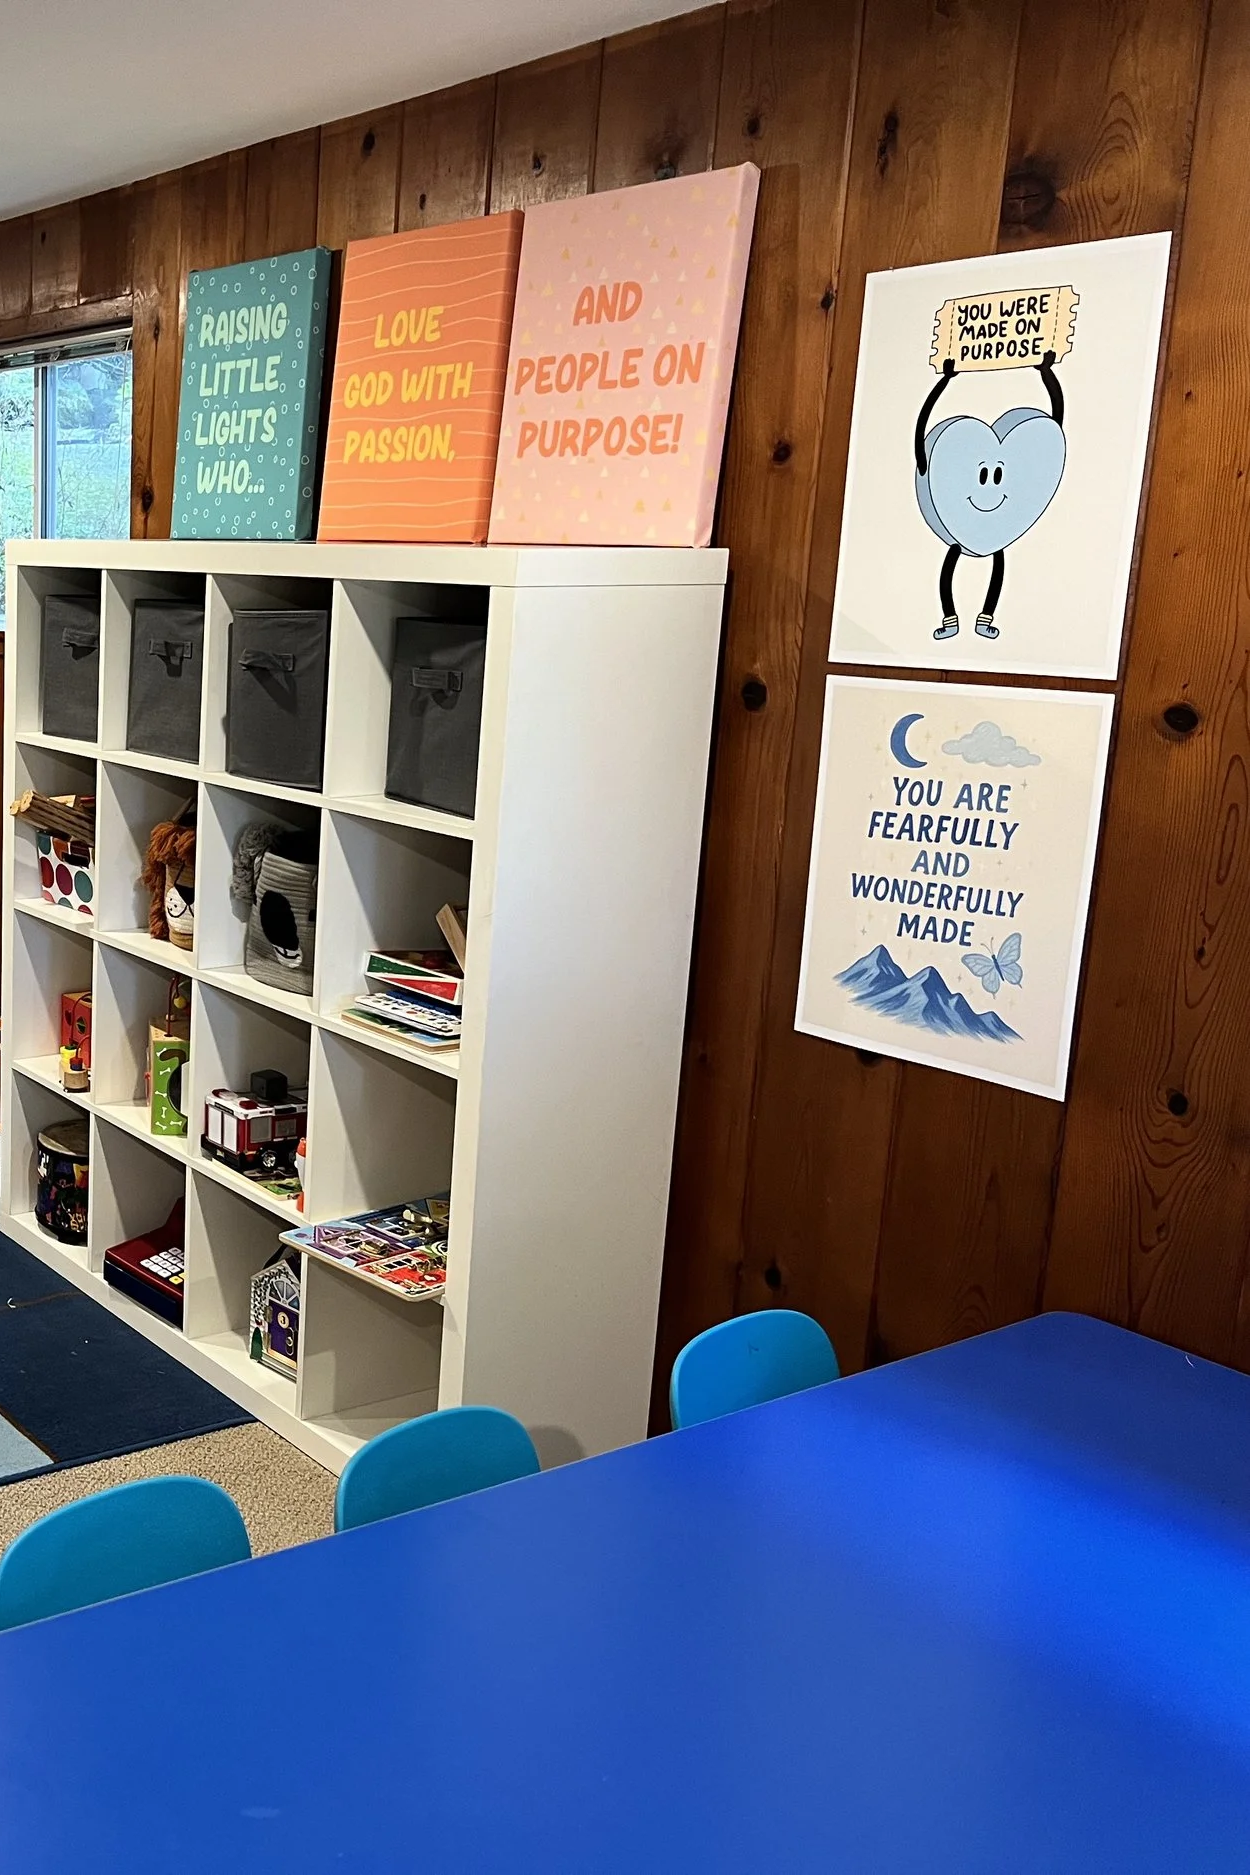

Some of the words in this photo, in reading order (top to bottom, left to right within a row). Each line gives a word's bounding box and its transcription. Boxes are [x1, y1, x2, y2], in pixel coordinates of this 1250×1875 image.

[572, 281, 643, 326] AND
[957, 302, 992, 326] YOU
[1000, 294, 1051, 318] WERE
[199, 302, 287, 347] RAISING
[373, 305, 445, 348] LOVE
[958, 320, 1008, 342] MADE
[1014, 317, 1041, 335] ON
[514, 347, 644, 396] PEOPLE
[652, 342, 706, 387] ON
[960, 337, 1044, 361] PURPOSE
[199, 355, 281, 397] LITTLE
[342, 370, 394, 408] GOD
[400, 361, 474, 404] WITH
[194, 407, 277, 446] LIGHTS
[342, 423, 457, 465] PASSION,
[516, 413, 684, 459] PURPOSE!
[196, 459, 265, 494] WHO...
[893, 776, 943, 807] YOU
[952, 782, 1011, 813] ARE
[867, 810, 1020, 851] FEARFULLY
[910, 850, 970, 878] AND
[851, 873, 1024, 918] WONDERFULLY
[896, 913, 975, 947] MADE
